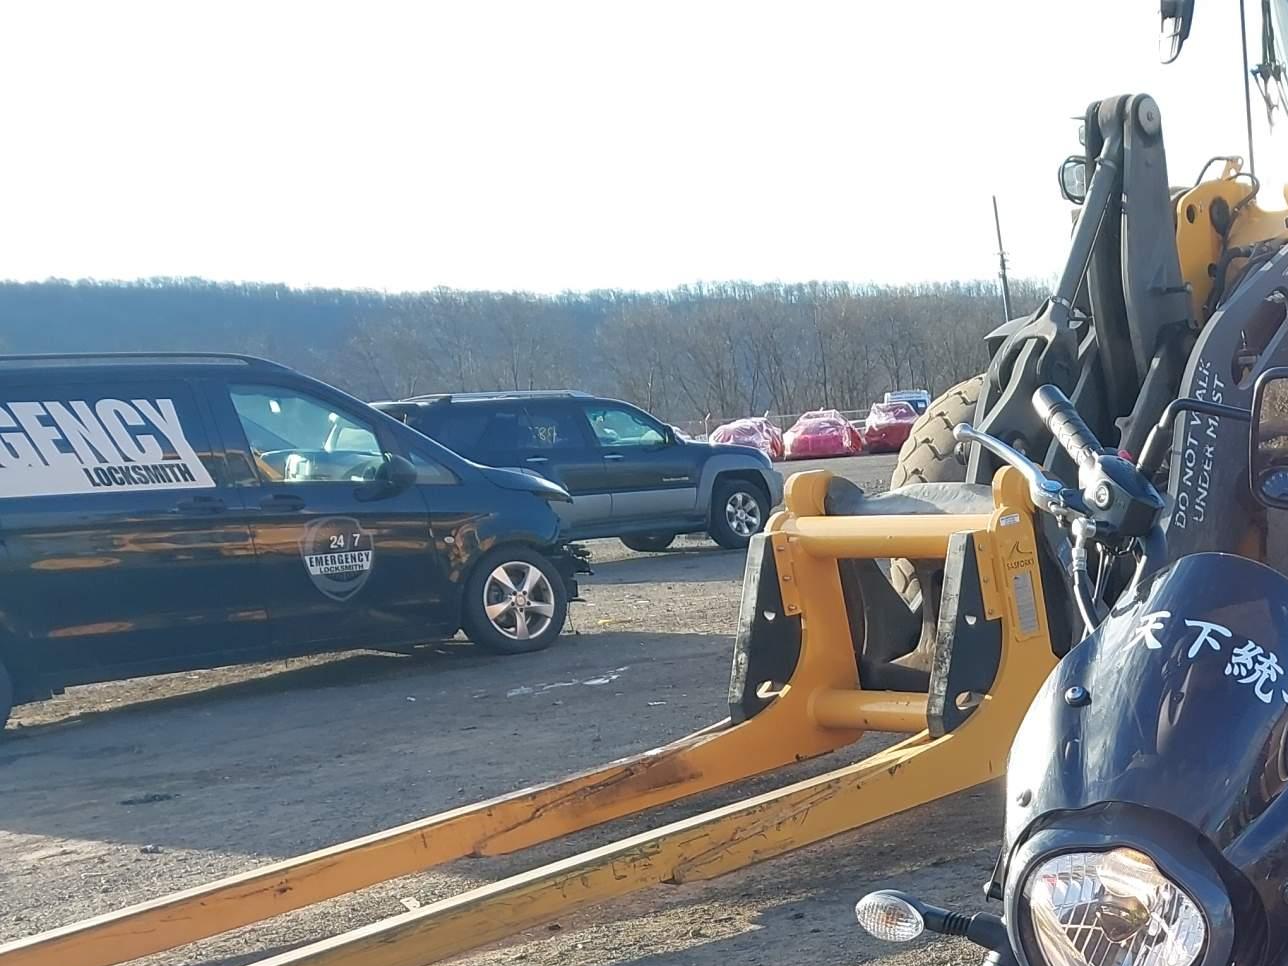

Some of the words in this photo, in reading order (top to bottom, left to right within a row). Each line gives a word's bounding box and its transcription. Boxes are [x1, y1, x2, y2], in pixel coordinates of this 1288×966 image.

[1193, 446, 1215, 522] UNDER
[1206, 374, 1225, 438] MST
[82, 463, 196, 488] LOCKSMITH
[1175, 492, 1189, 528] DO
[1183, 431, 1199, 486] NOT
[308, 551, 370, 568] EMERGENCY
[320, 564, 364, 573] LOCKSMITH
